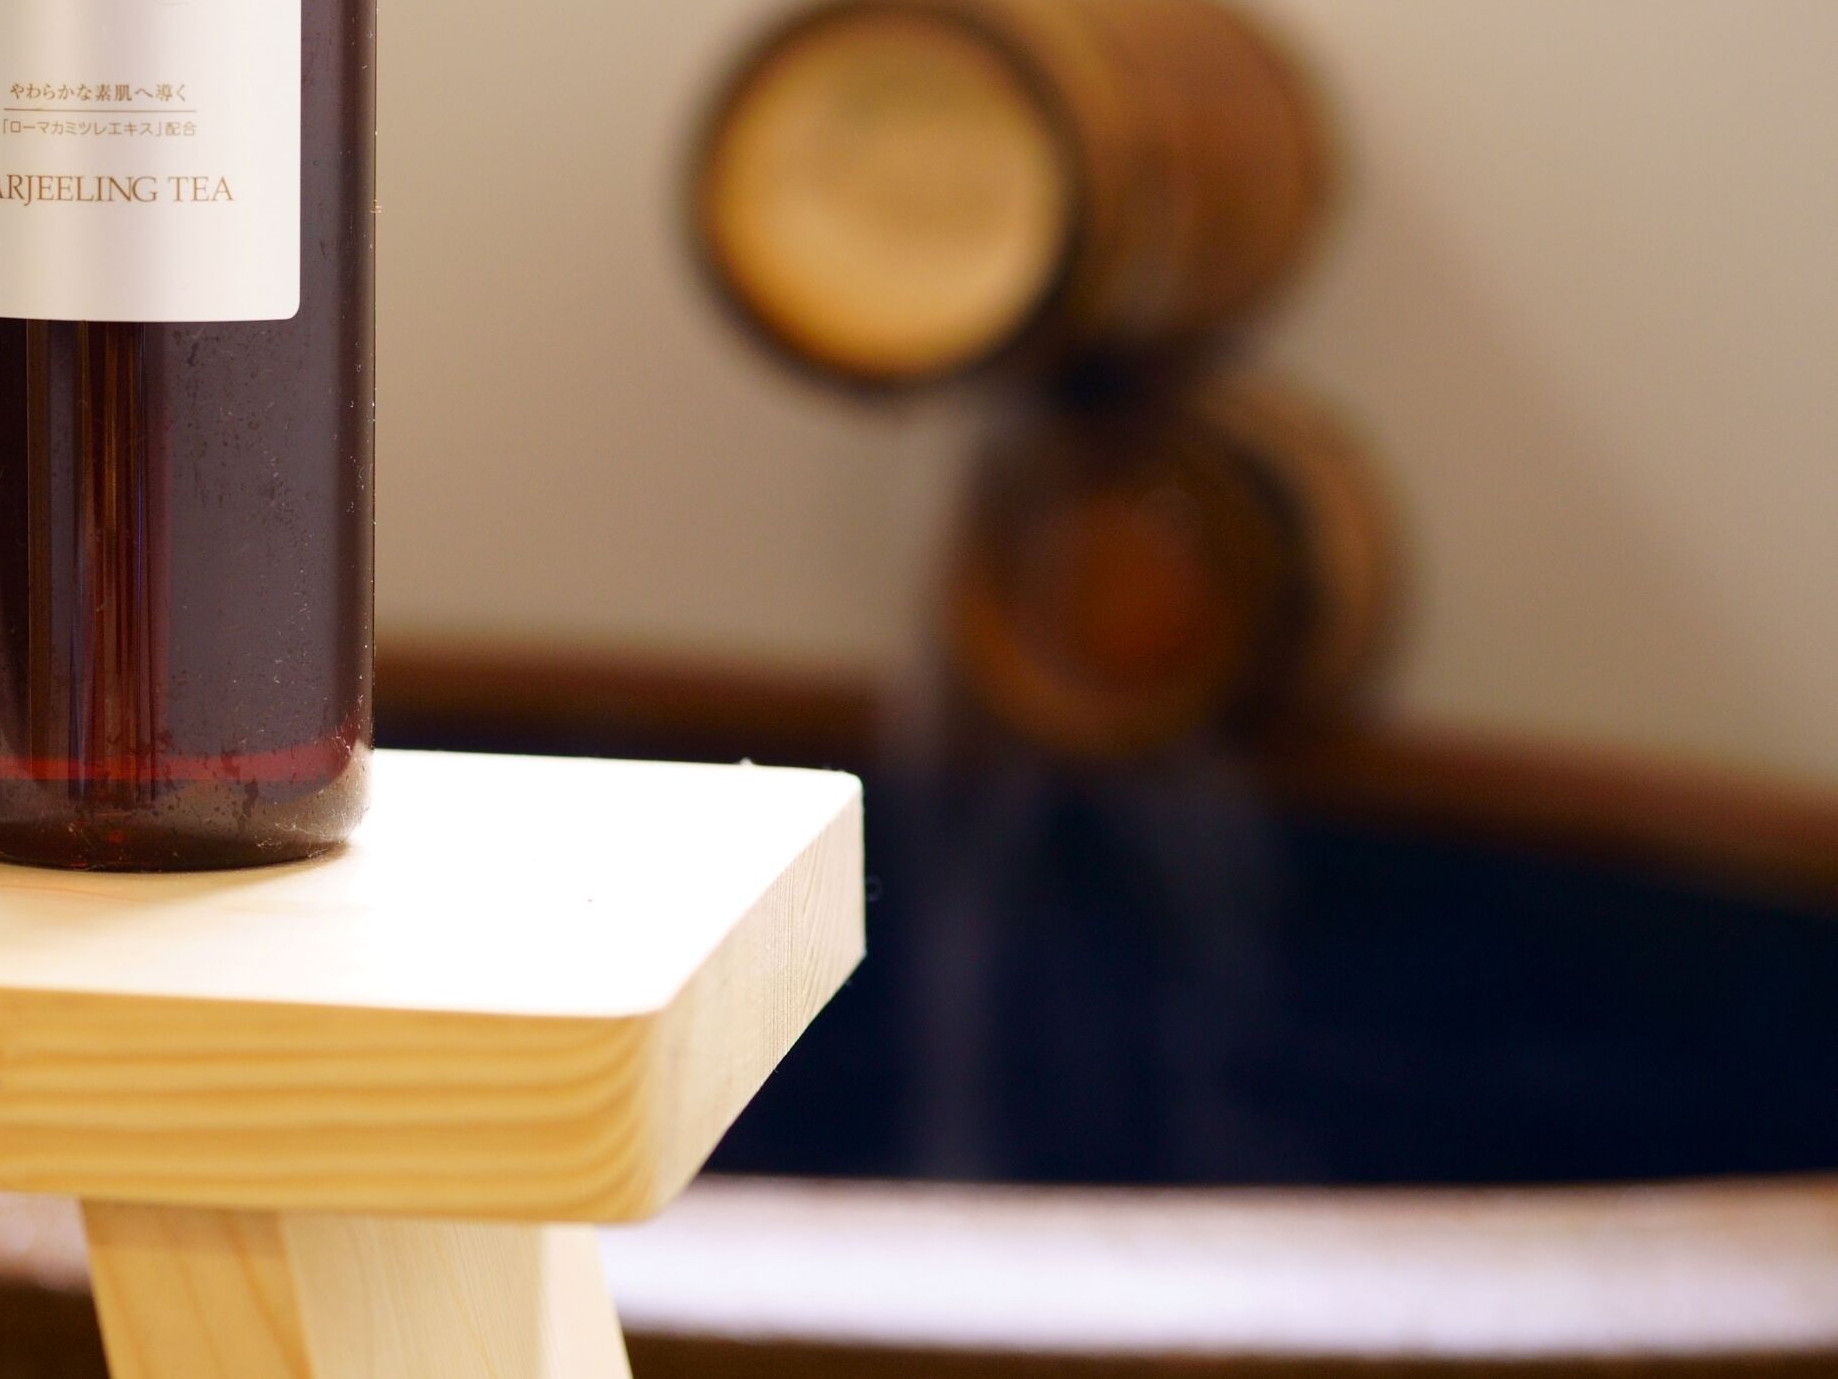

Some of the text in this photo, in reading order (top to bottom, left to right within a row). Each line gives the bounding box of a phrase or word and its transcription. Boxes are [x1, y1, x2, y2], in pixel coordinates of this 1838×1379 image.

[10, 83, 188, 102] やわらかな素肌へ導く
[2, 118, 197, 137] 「ローマカミツレエキス」配合
[167, 176, 234, 202] TEA
